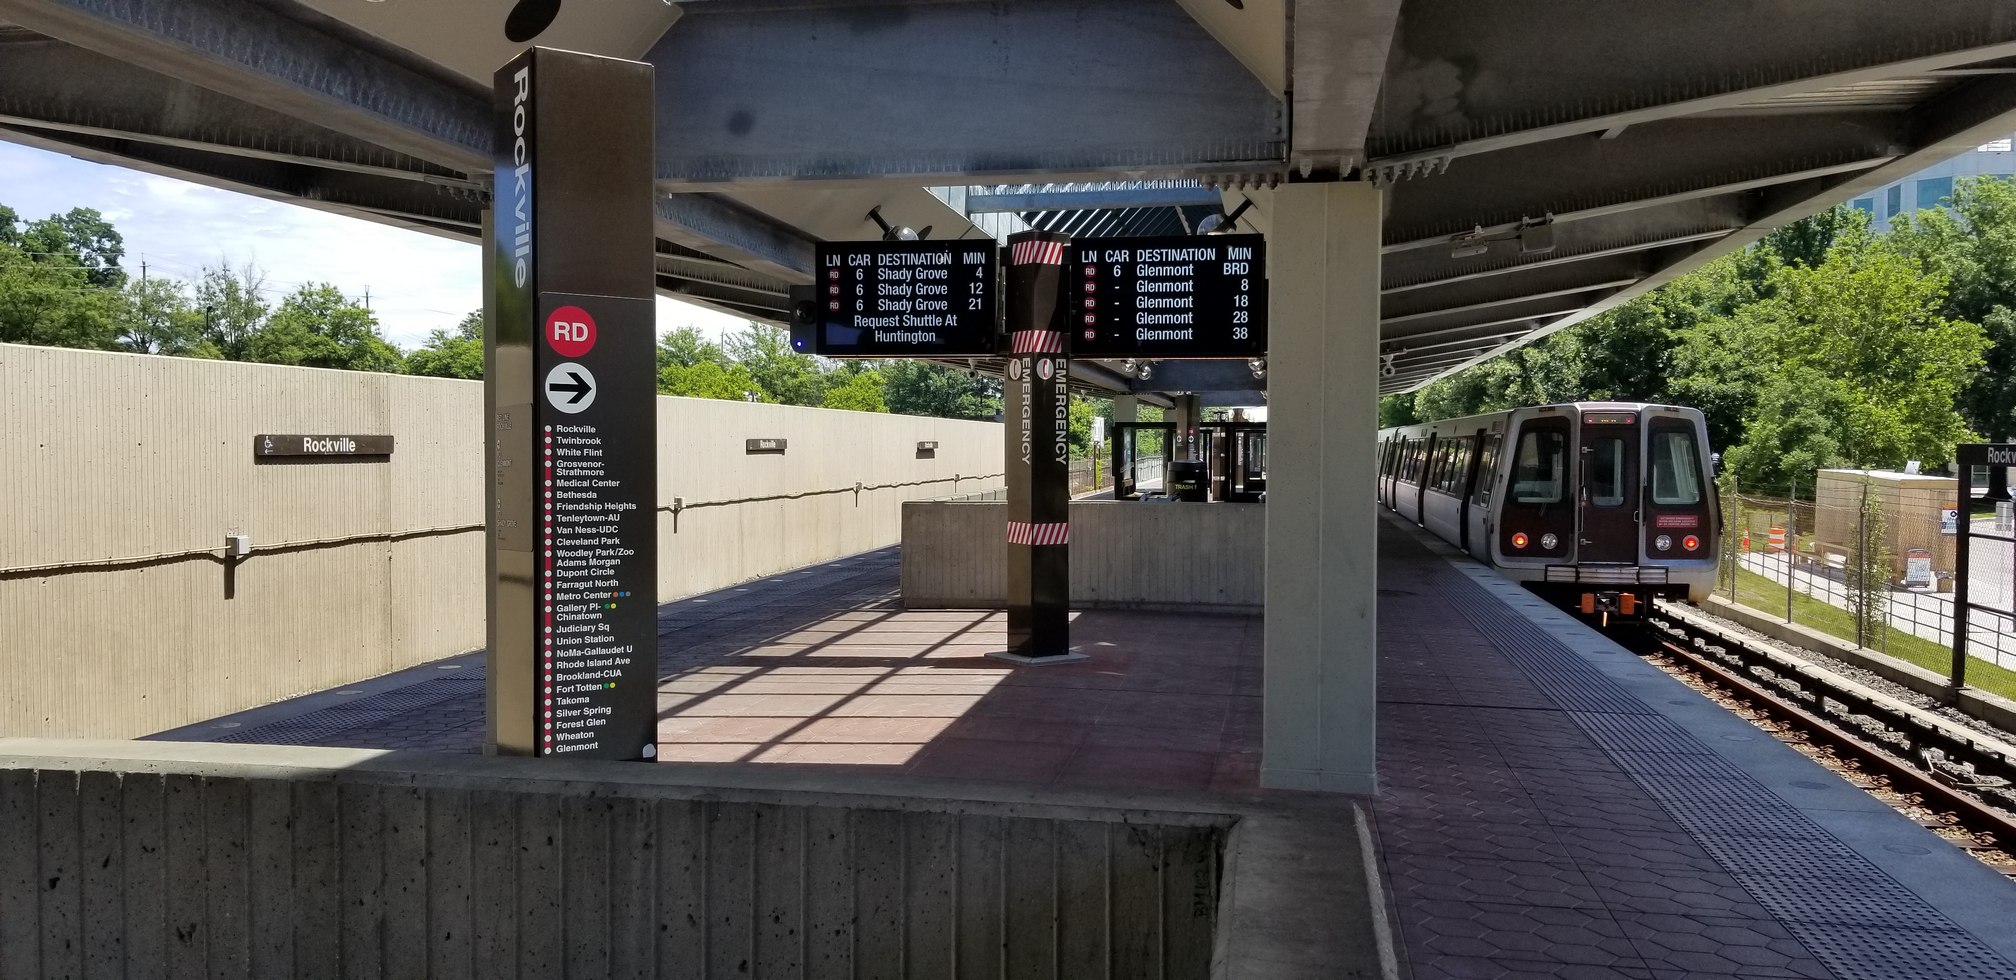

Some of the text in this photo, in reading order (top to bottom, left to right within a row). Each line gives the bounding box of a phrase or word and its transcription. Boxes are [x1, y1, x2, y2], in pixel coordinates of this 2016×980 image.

[514, 66, 530, 289] Rockville
[826, 252, 985, 267] LN CAR DESTINATION MIN
[1082, 247, 1252, 263] LN CAR DESTINATION MIN
[830, 267, 983, 282] RD 6 Shady Grove 4
[1113, 265, 1121, 277] 6
[1136, 264, 1193, 276] Glenmont
[1223, 263, 1249, 275] BRD
[856, 284, 863, 296] 6
[878, 283, 912, 297] Shady
[916, 283, 948, 295] Grove
[969, 282, 983, 294] 12
[1085, 283, 1095, 291] RD
[1136, 280, 1193, 292] Glenmont
[1241, 279, 1248, 291] 8
[856, 299, 863, 311] 6
[878, 299, 912, 313] Shady
[916, 299, 948, 310] Grove
[968, 298, 982, 310] 21
[1085, 299, 1095, 307] RD
[1136, 296, 1193, 308] Glenmont
[1234, 295, 1248, 307] 18
[854, 314, 957, 329] Request Shuttle At
[1085, 315, 1095, 323] RD
[1136, 312, 1193, 324] Glenmont
[1233, 311, 1248, 323] 28
[554, 321, 588, 342] RD
[875, 330, 936, 344] Huntington
[1085, 331, 1095, 339] RD
[1136, 328, 1193, 340] Glenmont
[1233, 327, 1248, 340] 38
[1022, 358, 1030, 465] EMERGENCY
[1055, 359, 1066, 465] EMERGENCY
[556, 425, 596, 433] Rockville
[303, 437, 356, 453] Rockville
[556, 436, 601, 445] Twinbrook
[556, 448, 581, 456] White
[556, 460, 605, 468] Grosvenor-
[556, 468, 605, 476] Strathmore
[556, 479, 589, 487] Medical
[556, 502, 636, 511] Friendship Heights
[556, 514, 620, 523] Tenleytown-AU
[556, 525, 618, 534] Van Ness-UDC
[556, 537, 620, 546] Cleveland Park
[556, 548, 634, 558] Woodley Park/Zoo
[556, 558, 621, 567] Adams Morgan
[556, 568, 615, 578] Dupont Circle
[556, 579, 619, 590] Farragut North
[556, 591, 612, 601] Metro Center
[556, 604, 587, 613] Gallery
[556, 613, 602, 621] Chinatown
[556, 623, 610, 633] Judiciary Sq
[556, 635, 614, 645] Union Station
[556, 645, 633, 657] NoMa-Gallaudet U
[556, 657, 631, 669] Rhode Island Ave
[556, 669, 622, 681] Brookland-CUA
[556, 683, 602, 694] Fort Totten
[556, 696, 590, 705] Takoma
[556, 706, 611, 717] Silver Spring
[556, 718, 606, 729] Forest Glen
[556, 731, 594, 741] Wheaton
[556, 742, 598, 753] Glenmont
